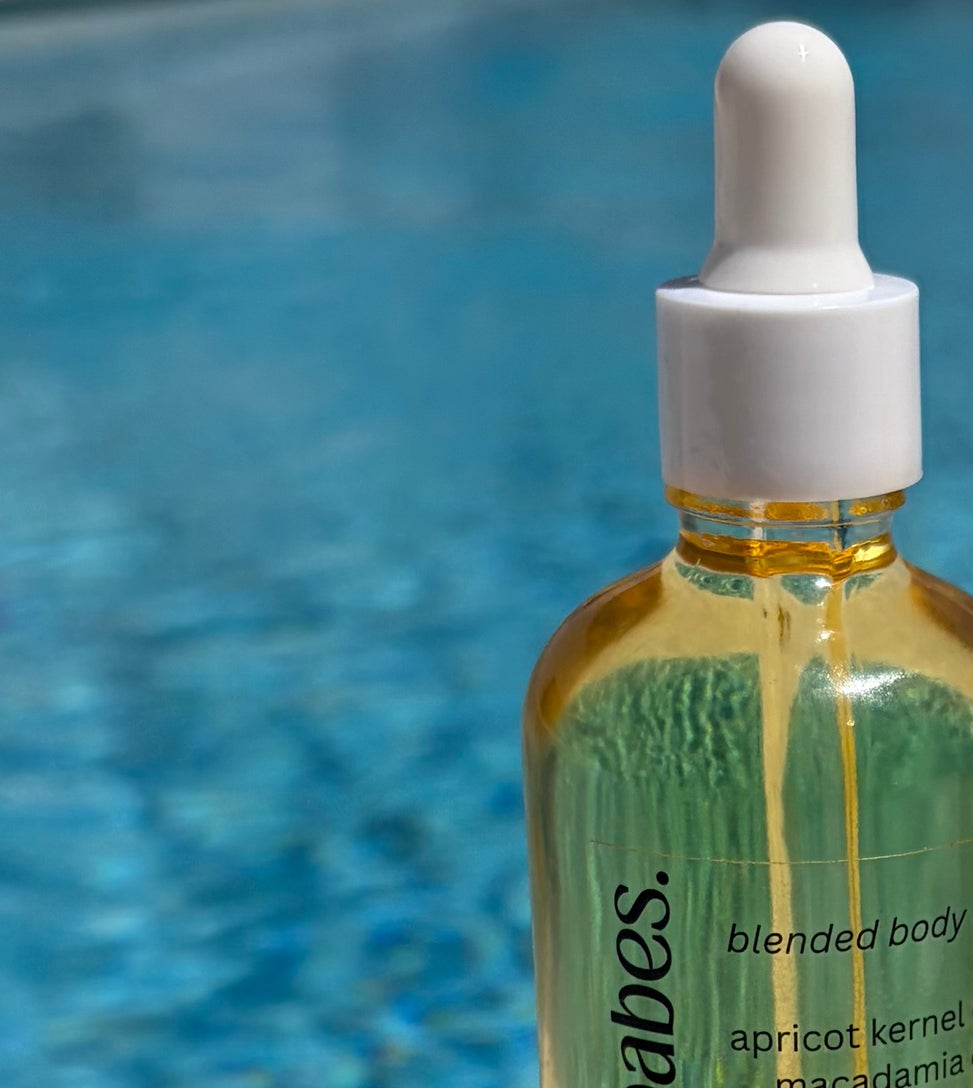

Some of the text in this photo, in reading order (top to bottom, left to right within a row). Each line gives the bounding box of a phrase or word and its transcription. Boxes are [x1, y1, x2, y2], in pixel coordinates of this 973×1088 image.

[728, 920, 879, 954] blended
[889, 904, 966, 948] body
[731, 1022, 860, 1057] apricot
[872, 1008, 964, 1046] kernel
